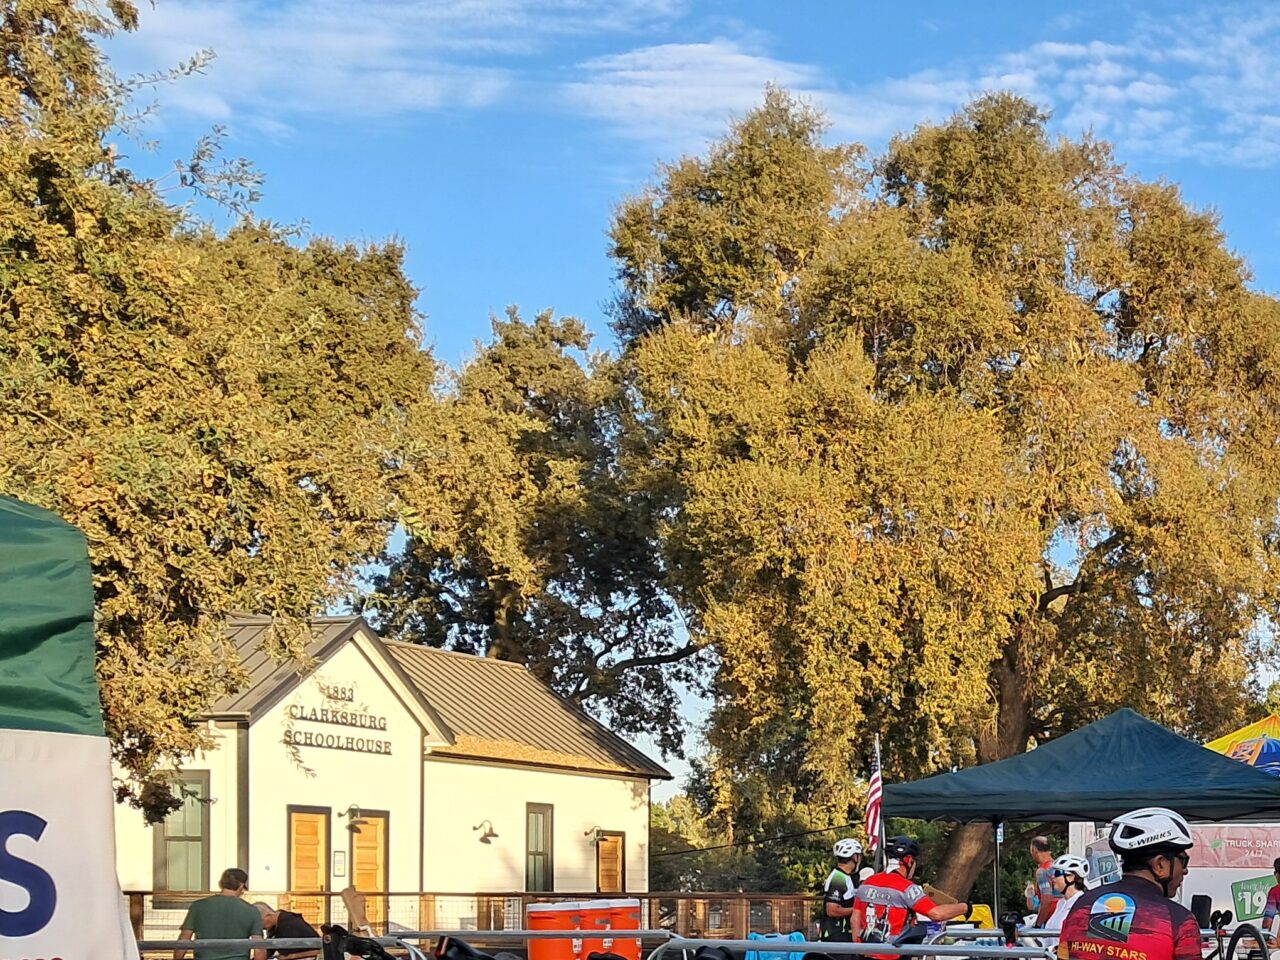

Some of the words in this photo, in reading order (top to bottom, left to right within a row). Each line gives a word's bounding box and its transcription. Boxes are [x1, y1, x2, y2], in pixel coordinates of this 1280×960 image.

[327, 685, 354, 702] 1883
[289, 704, 387, 731] CLARKSBURG
[284, 729, 392, 755] SCHOOLHOUSE
[1128, 829, 1172, 849] S-WORKS
[1225, 840, 1253, 848] TRUCK
[0, 810, 57, 938] S
[1071, 941, 1104, 953] HI-WAY
